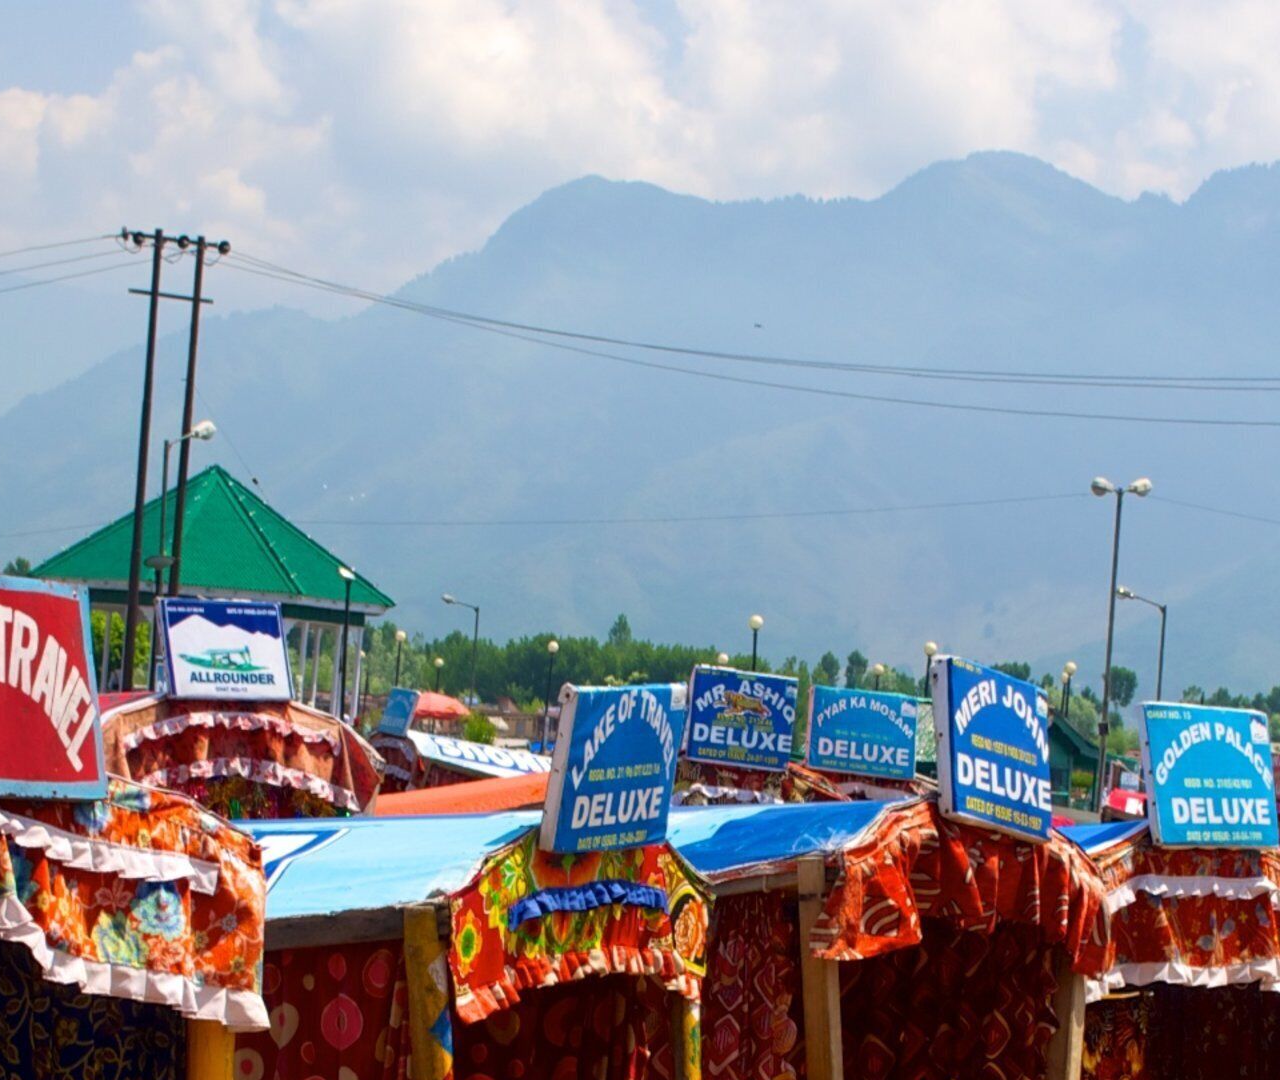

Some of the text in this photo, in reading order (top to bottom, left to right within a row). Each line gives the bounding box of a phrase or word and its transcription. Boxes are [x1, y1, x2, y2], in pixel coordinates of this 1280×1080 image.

[190, 671, 276, 685] ALLROUNDER
[695, 680, 796, 725] MR ASHIQ
[817, 699, 847, 728] PYAR
[850, 696, 867, 709] KA
[954, 679, 1050, 764] MERI JOHN
[572, 689, 675, 791] LAKE OF TRAVEL
[693, 722, 793, 753] DELUXE
[817, 737, 910, 767] DELUXE
[1156, 721, 1212, 785] GOLDEN
[1214, 721, 1273, 790] PALACE
[956, 752, 1052, 812] DELUXE
[571, 786, 664, 830] DELUXE
[1171, 797, 1272, 825] DELUXE
